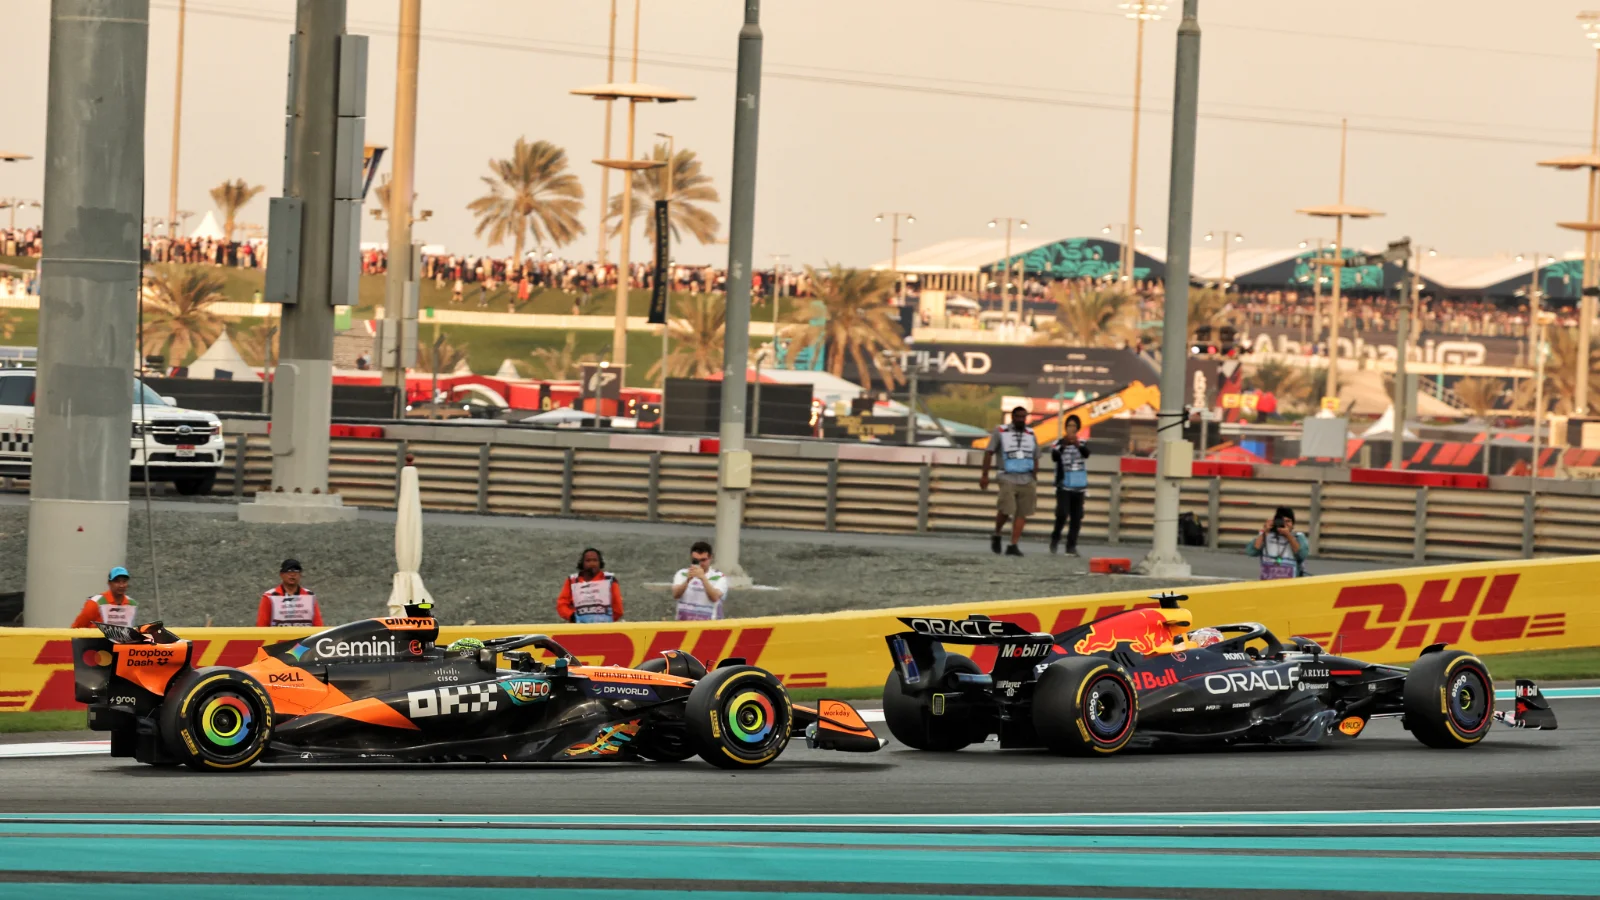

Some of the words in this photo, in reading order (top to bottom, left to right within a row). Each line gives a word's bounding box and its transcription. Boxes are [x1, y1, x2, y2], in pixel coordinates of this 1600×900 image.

[1328, 573, 1531, 654] DHL
[385, 618, 432, 627] allwyn
[911, 619, 1004, 636] ORACLE
[315, 635, 396, 658] Gemini
[1001, 643, 1039, 658] Mobil
[128, 648, 174, 658] Dropbox
[126, 658, 154, 667] Dash
[269, 672, 304, 683] DELL
[593, 671, 628, 680] RICHARD
[629, 673, 653, 681] MILLE
[1142, 668, 1179, 690] Bull
[1301, 669, 1330, 678] ARLYLE
[1204, 666, 1300, 695] ORACLE
[509, 681, 550, 697] VELO
[603, 686, 616, 694] DP
[617, 687, 649, 696] WORLD
[1516, 685, 1538, 697] Mobil
[116, 695, 136, 705] groq
[823, 710, 851, 718] workday
